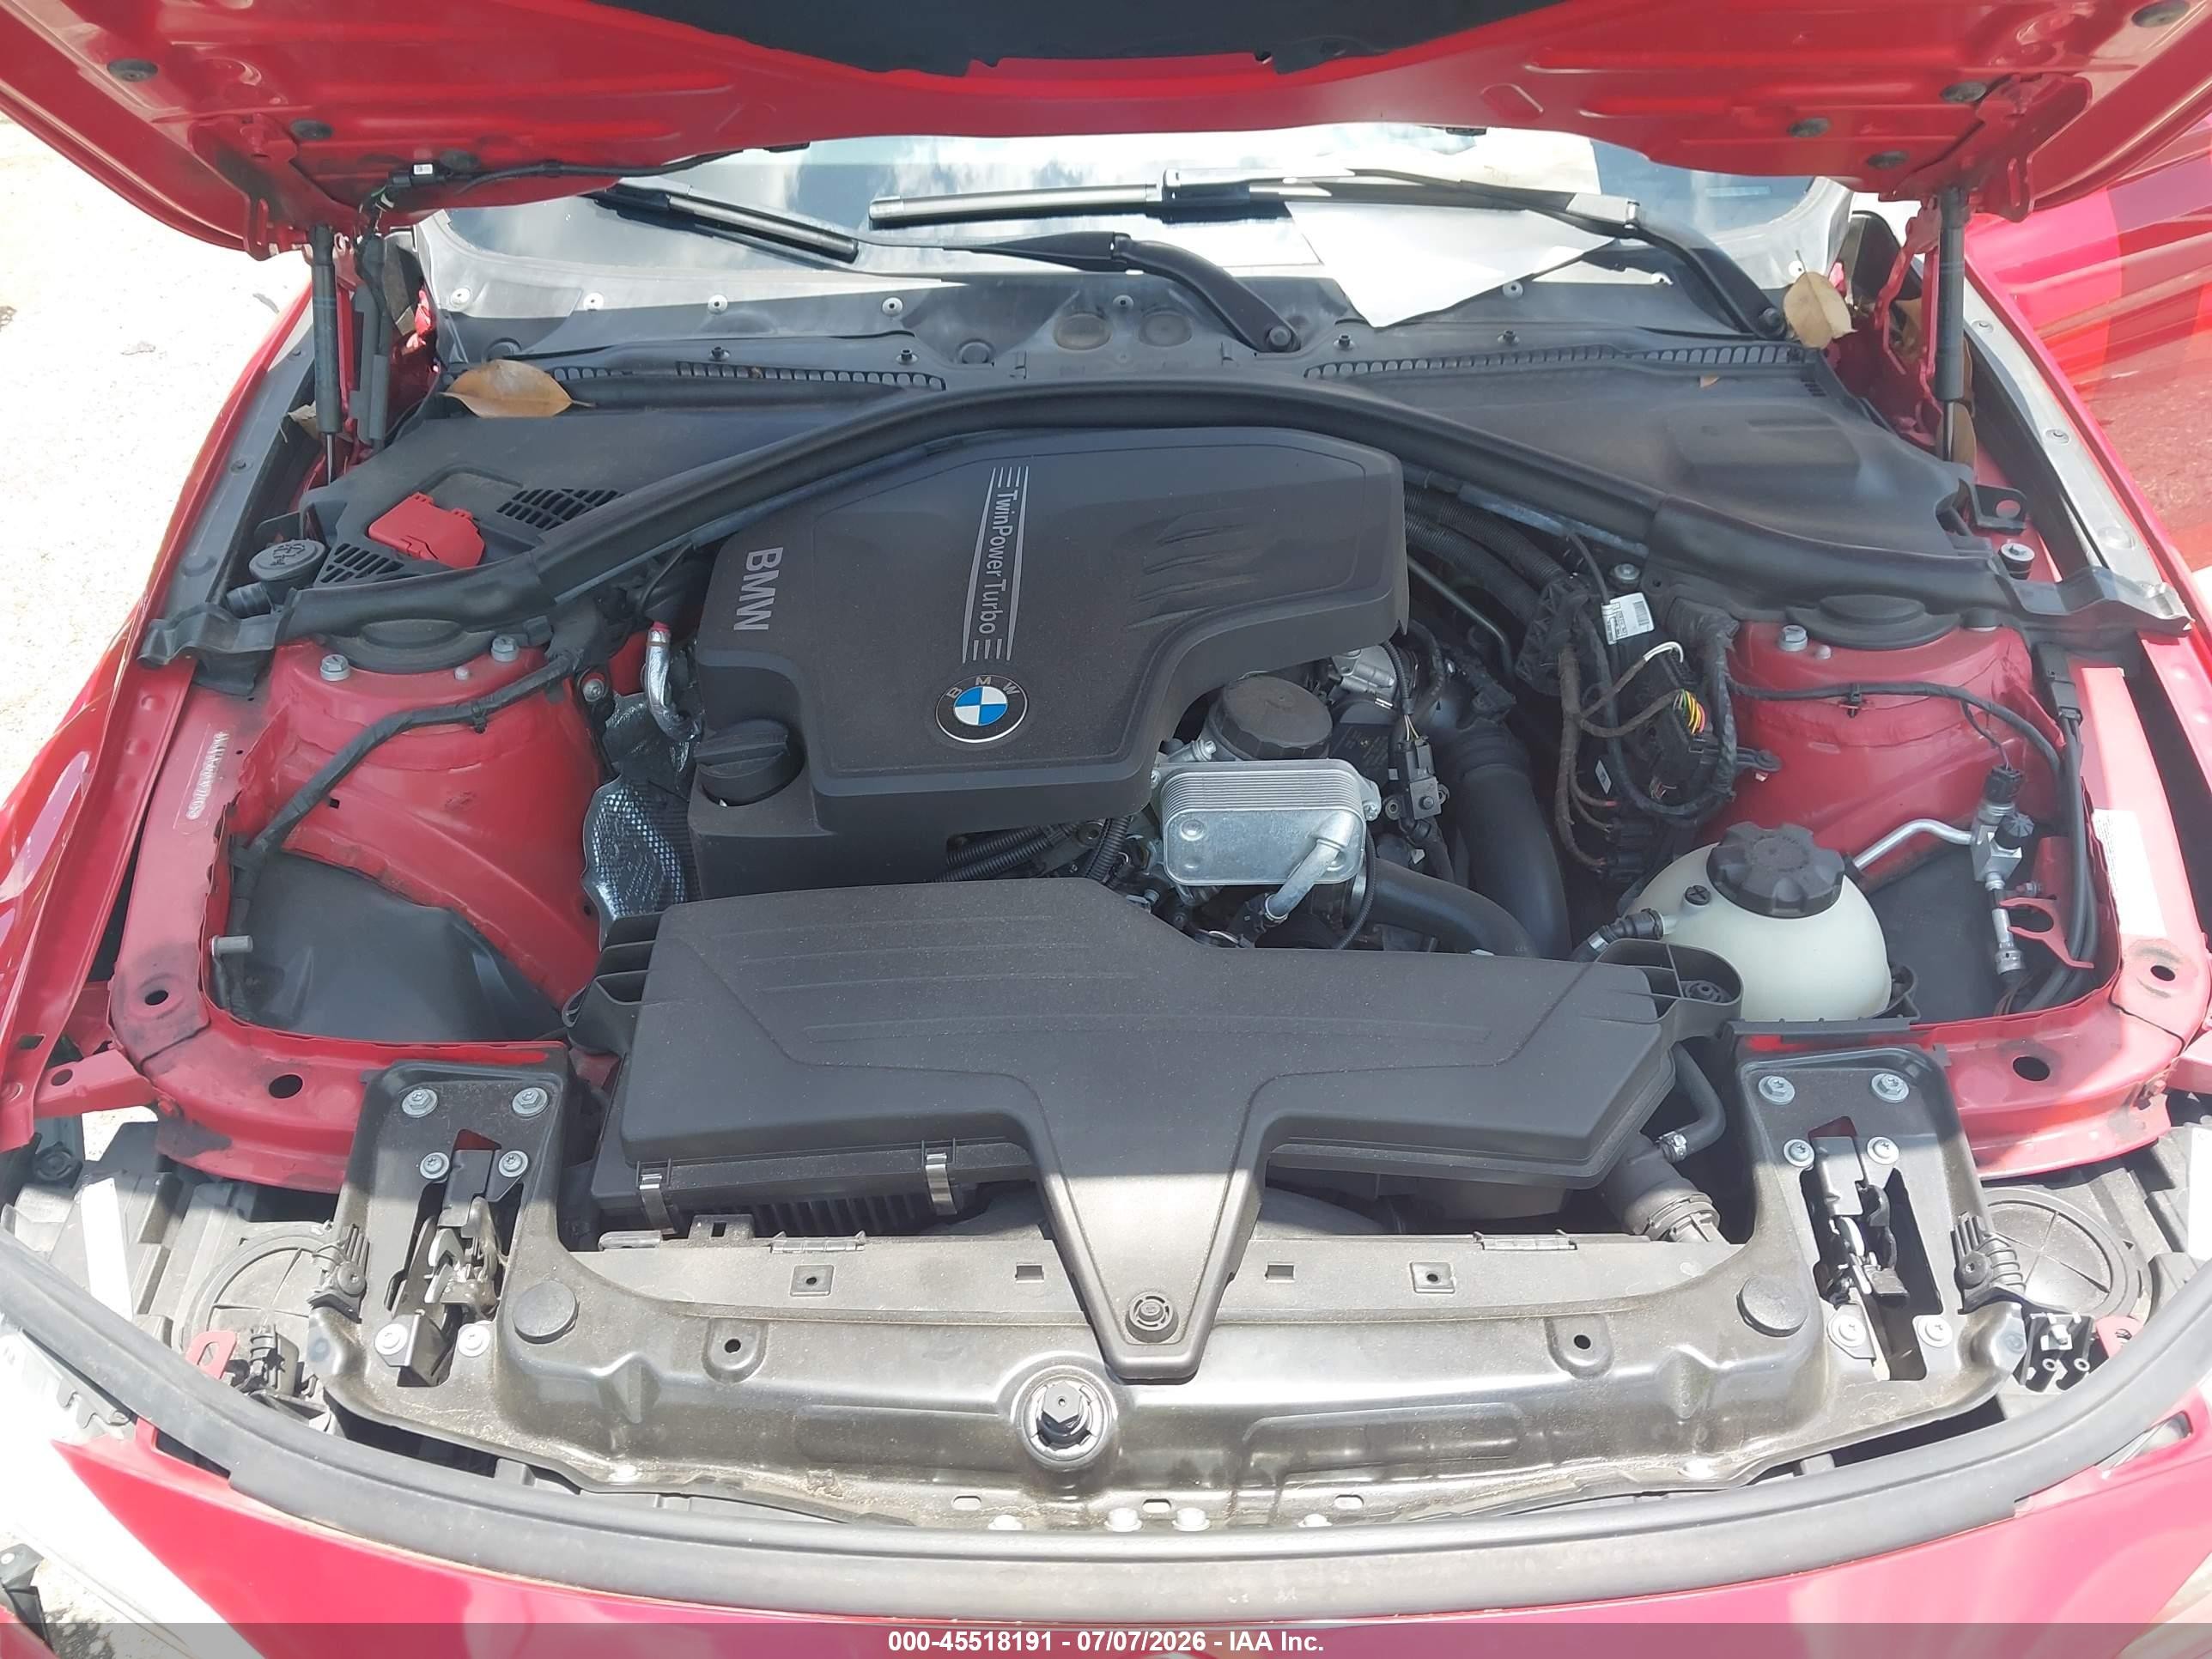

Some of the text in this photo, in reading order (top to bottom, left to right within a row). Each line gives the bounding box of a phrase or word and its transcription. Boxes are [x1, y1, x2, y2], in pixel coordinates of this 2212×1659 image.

[733, 547, 783, 630] BMW
[978, 489, 1018, 635] TwinPower Turbo
[946, 676, 1020, 699] BMW
